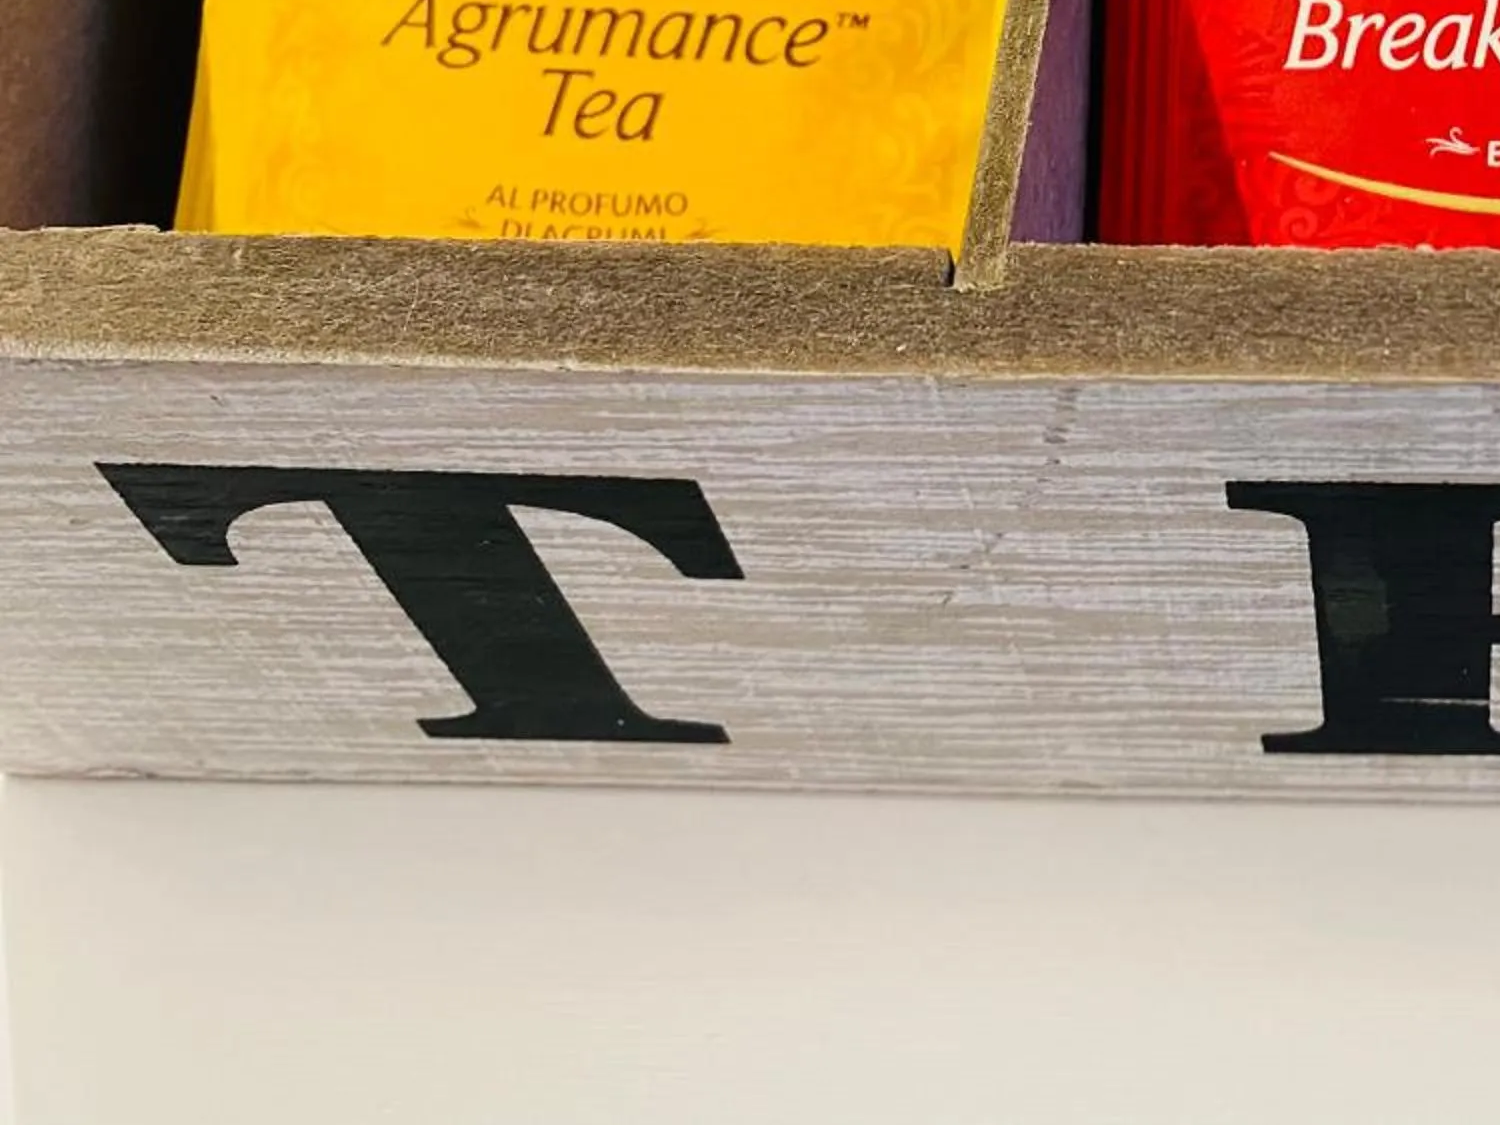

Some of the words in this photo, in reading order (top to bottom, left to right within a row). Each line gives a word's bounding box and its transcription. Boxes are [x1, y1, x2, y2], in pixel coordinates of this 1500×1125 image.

[540, 70, 667, 143] Tea
[486, 184, 524, 210] AL
[530, 188, 689, 218] PROFUMO
